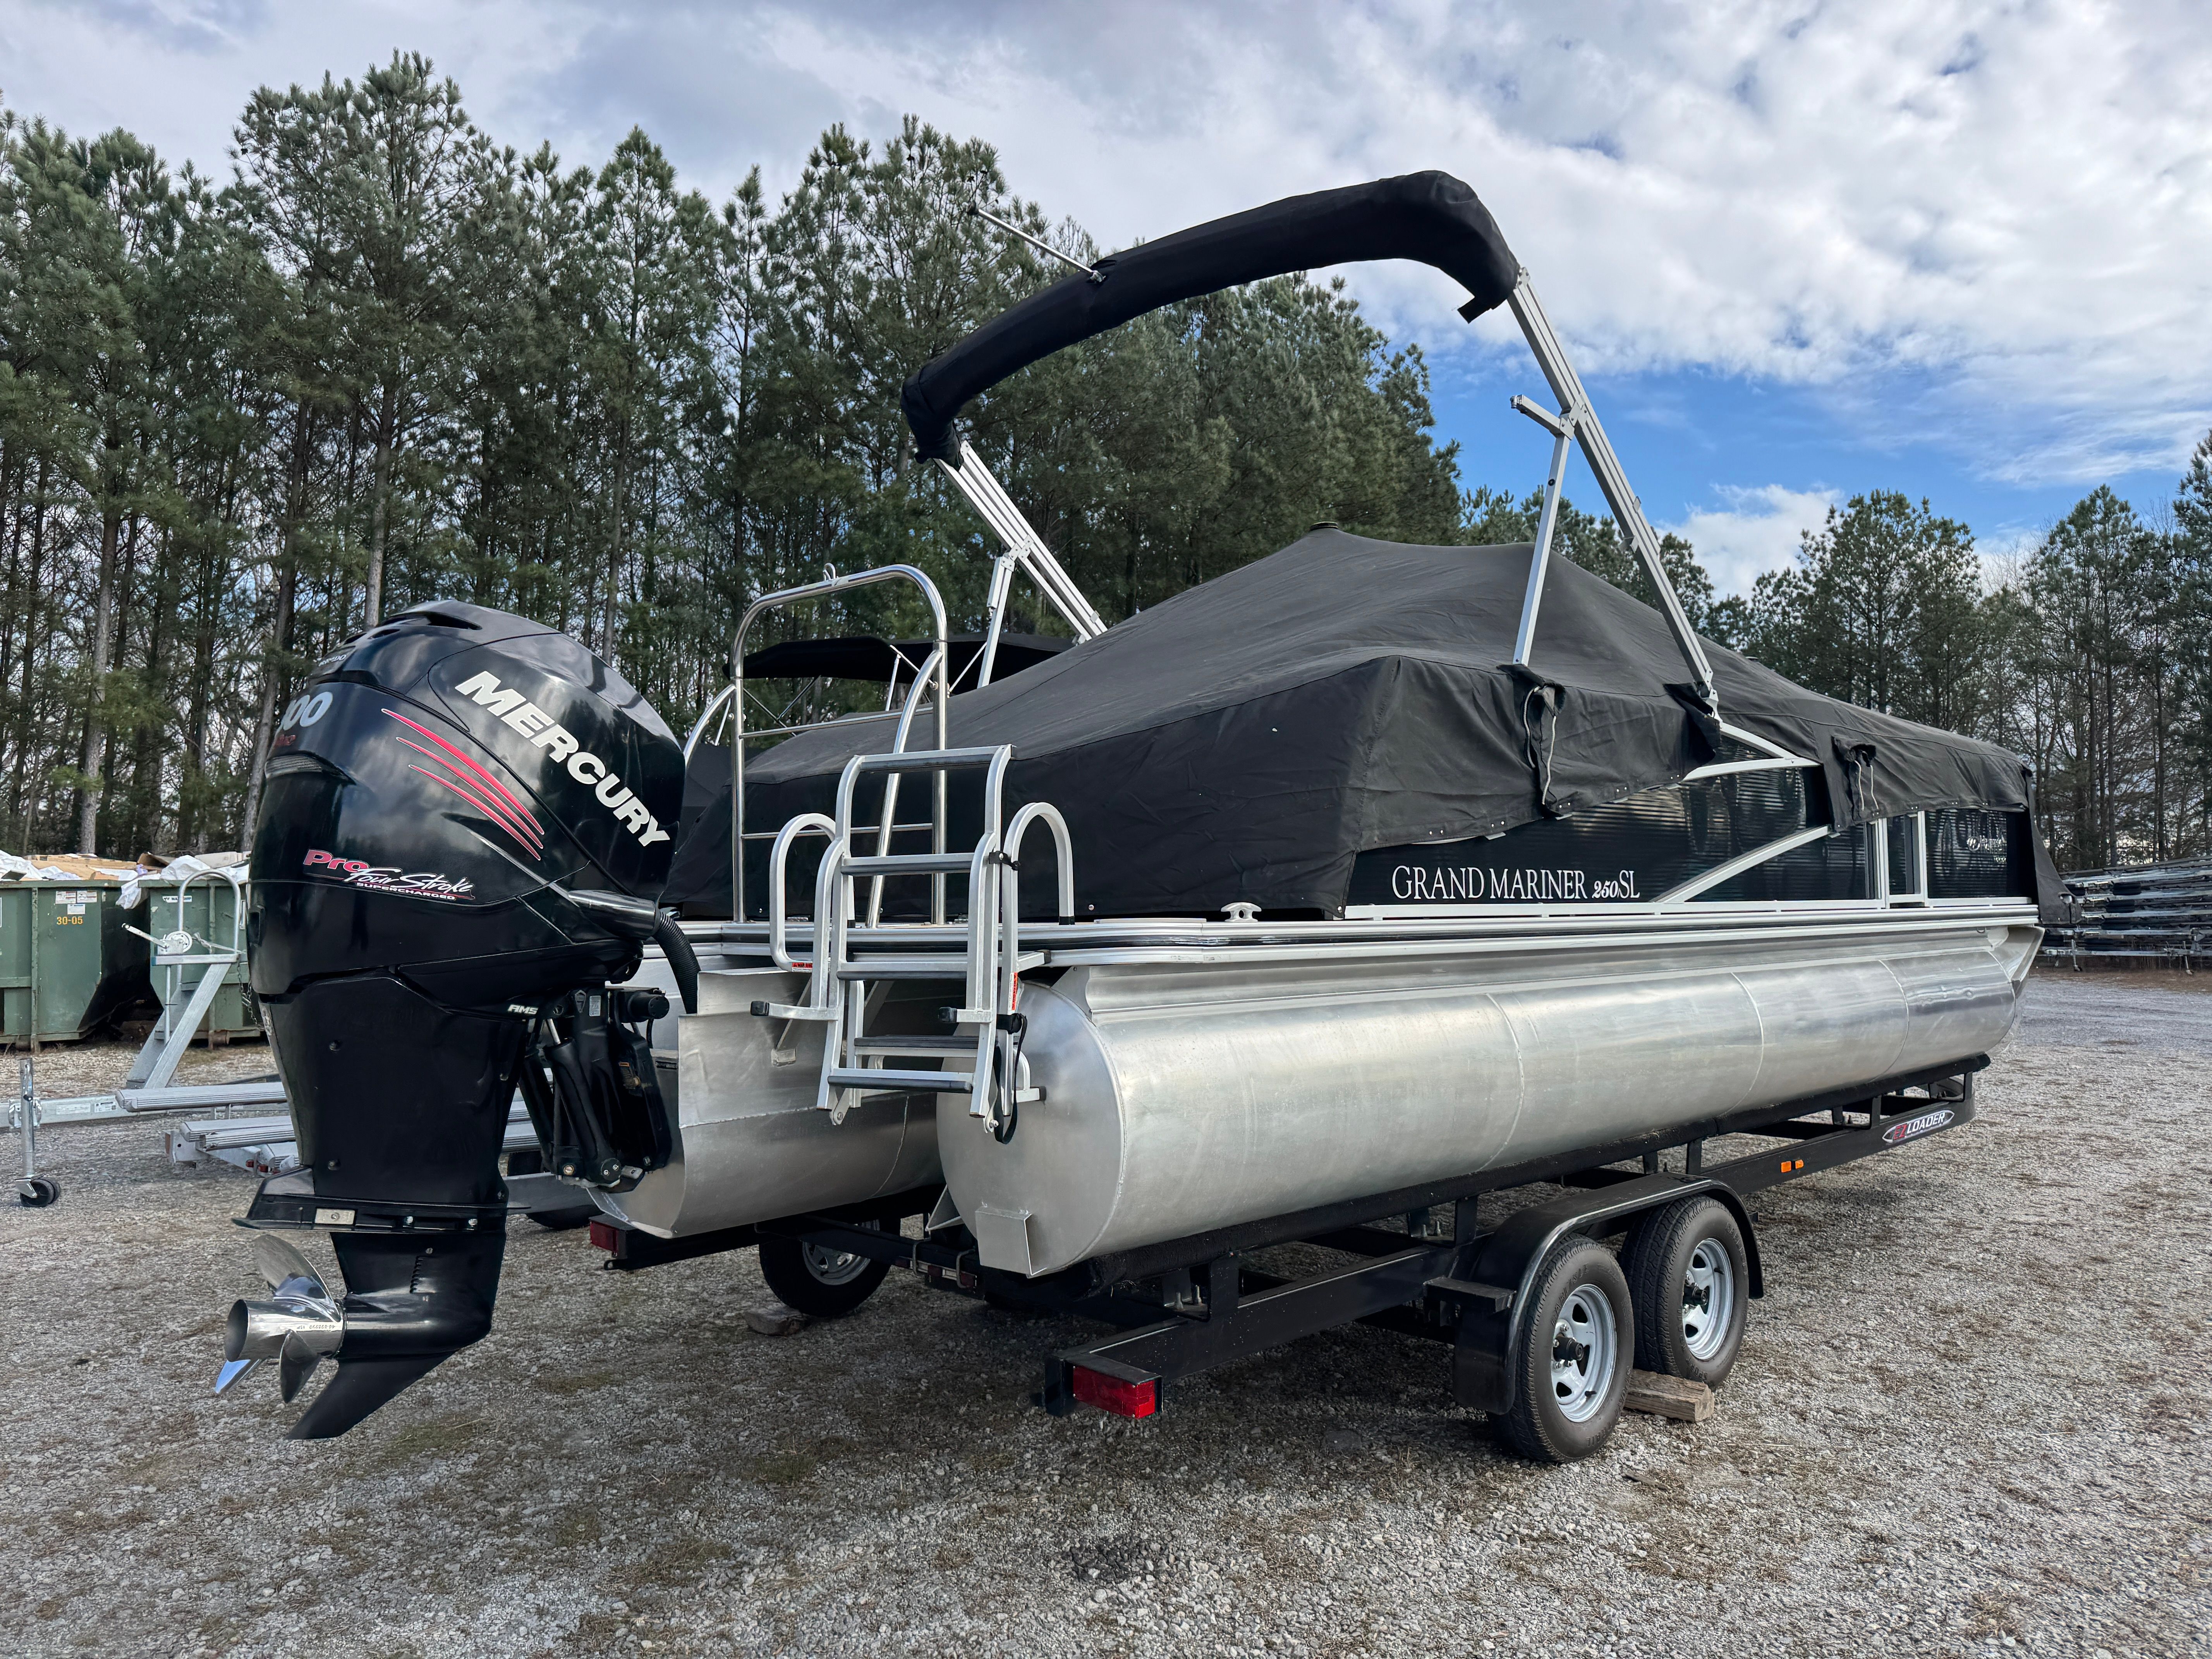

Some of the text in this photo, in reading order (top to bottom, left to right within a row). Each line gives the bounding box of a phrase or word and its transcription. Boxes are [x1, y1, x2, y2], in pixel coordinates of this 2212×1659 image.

[455, 670, 670, 847] MERCURY
[303, 849, 369, 873] Pro
[356, 882, 456, 900] SUPERCHARGED
[1392, 865, 1484, 899] GRAND
[1489, 868, 1588, 899] MARINER
[57, 916, 83, 925] 30-05
[508, 1004, 539, 1015] AMS
[1893, 1111, 1946, 1140] EZ LOADER
